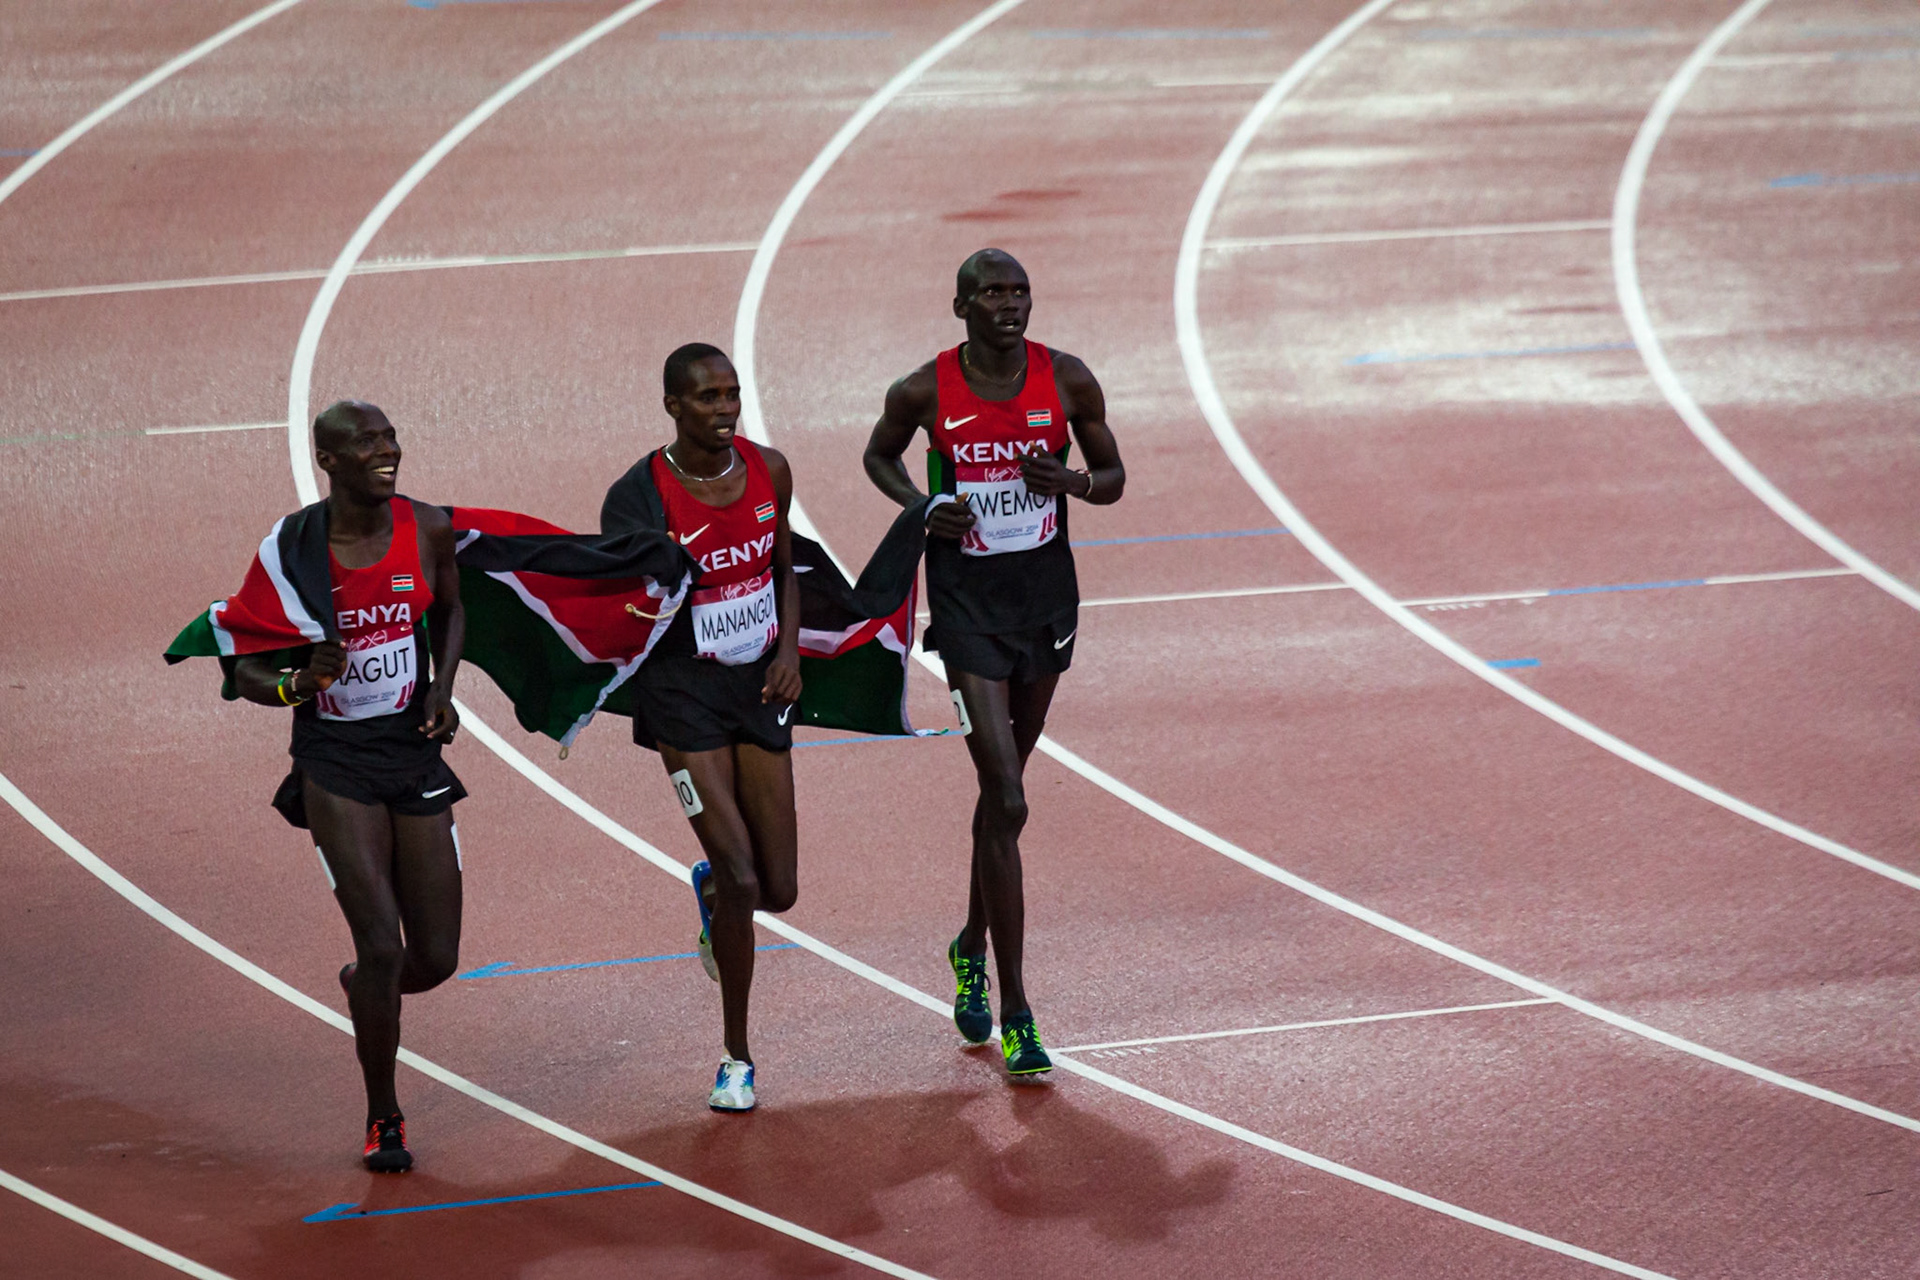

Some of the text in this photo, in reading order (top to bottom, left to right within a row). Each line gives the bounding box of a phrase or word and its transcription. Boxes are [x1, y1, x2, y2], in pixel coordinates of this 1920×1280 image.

[337, 603, 411, 629] ENYA
[340, 647, 410, 686] AGUT
[340, 693, 379, 705] GLASGOW
